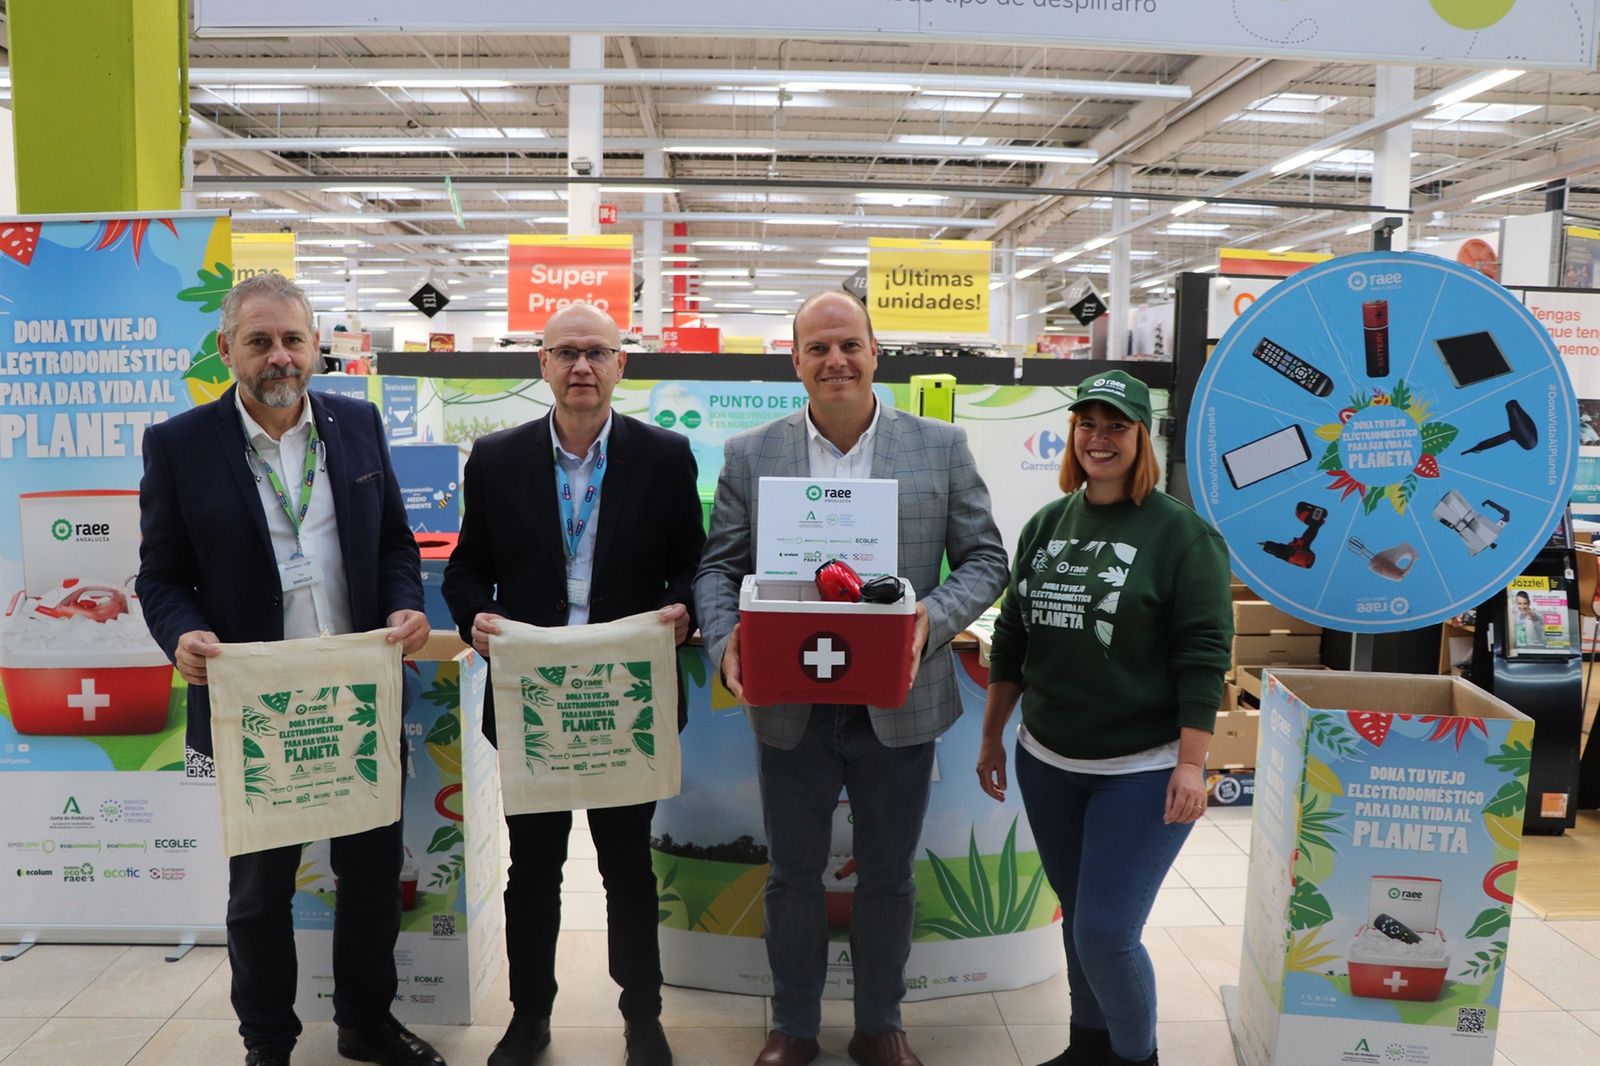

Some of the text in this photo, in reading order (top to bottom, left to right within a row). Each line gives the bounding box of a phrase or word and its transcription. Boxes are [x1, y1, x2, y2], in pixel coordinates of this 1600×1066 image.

[531, 264, 608, 289] Super
[885, 264, 974, 290] ¡Últimas
[1370, 272, 1402, 285] raee
[423, 293, 437, 308] TEX
[878, 293, 982, 310] unidades!
[1530, 307, 1581, 323] Tengas
[14, 317, 157, 344] DONA TU VIEJO
[1548, 327, 1573, 340] que
[1376, 333, 1384, 367] BATTERY
[1559, 345, 1600, 356] nemo
[0, 345, 190, 376] LECTRODOMÉSTICO
[0, 379, 175, 405] PARA DAR VIDA AL
[709, 395, 763, 408] PUNTO
[768, 396, 788, 408] DE
[1353, 421, 1374, 430] DONA
[1375, 420, 1385, 428] TU
[1021, 461, 1060, 470] Carrefo
[1348, 450, 1413, 469] PLANETA
[825, 488, 852, 498] raee
[75, 522, 110, 536] raee
[1069, 565, 1089, 573] raee
[1042, 582, 1086, 593] DONA TU VIEJO
[1512, 579, 1544, 588] Jazztel
[1032, 600, 1086, 613] PARA DAR VIDA AL
[1031, 609, 1084, 629] PLANETA
[608, 709, 616, 717] AL
[289, 716, 333, 728] DONA TU VIEJO
[563, 718, 616, 732] PLANETA
[284, 740, 301, 748] PARA
[302, 738, 315, 746] DAR
[316, 736, 330, 744] VIDA
[285, 743, 340, 763] PLANETA
[1370, 766, 1465, 785] DONA TU VIEJO
[1347, 783, 1484, 805] ELECTRODOMÉSTICO
[1355, 802, 1472, 823] PARA DAR VIDA AL
[155, 839, 197, 848] ECOLEC
[1353, 820, 1469, 854] PLANETA
[104, 867, 140, 878] ecotic
[1401, 890, 1423, 899] raee
[414, 976, 444, 984] ECOLEC
